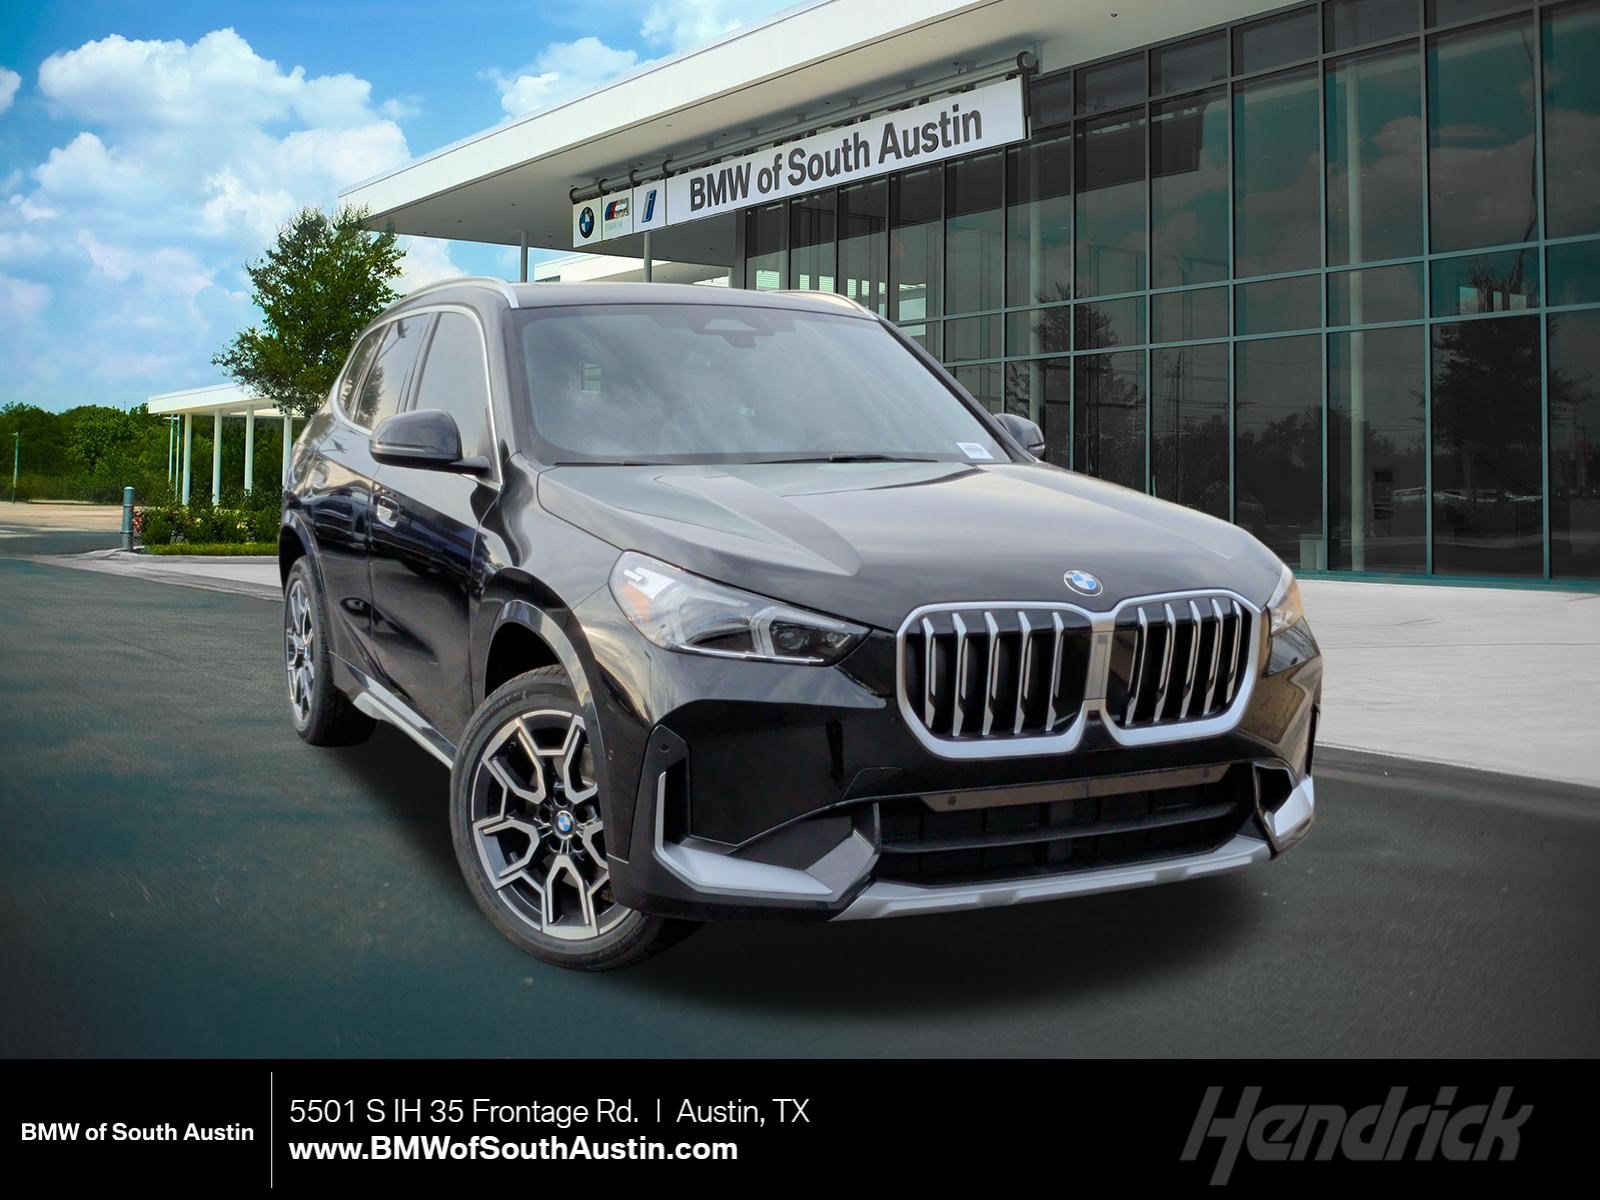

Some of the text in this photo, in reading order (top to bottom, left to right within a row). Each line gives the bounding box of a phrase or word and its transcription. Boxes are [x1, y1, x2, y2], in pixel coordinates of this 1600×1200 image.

[690, 162, 752, 212] BMW
[757, 153, 783, 194] of
[787, 131, 870, 187] South
[878, 104, 983, 164] Austin
